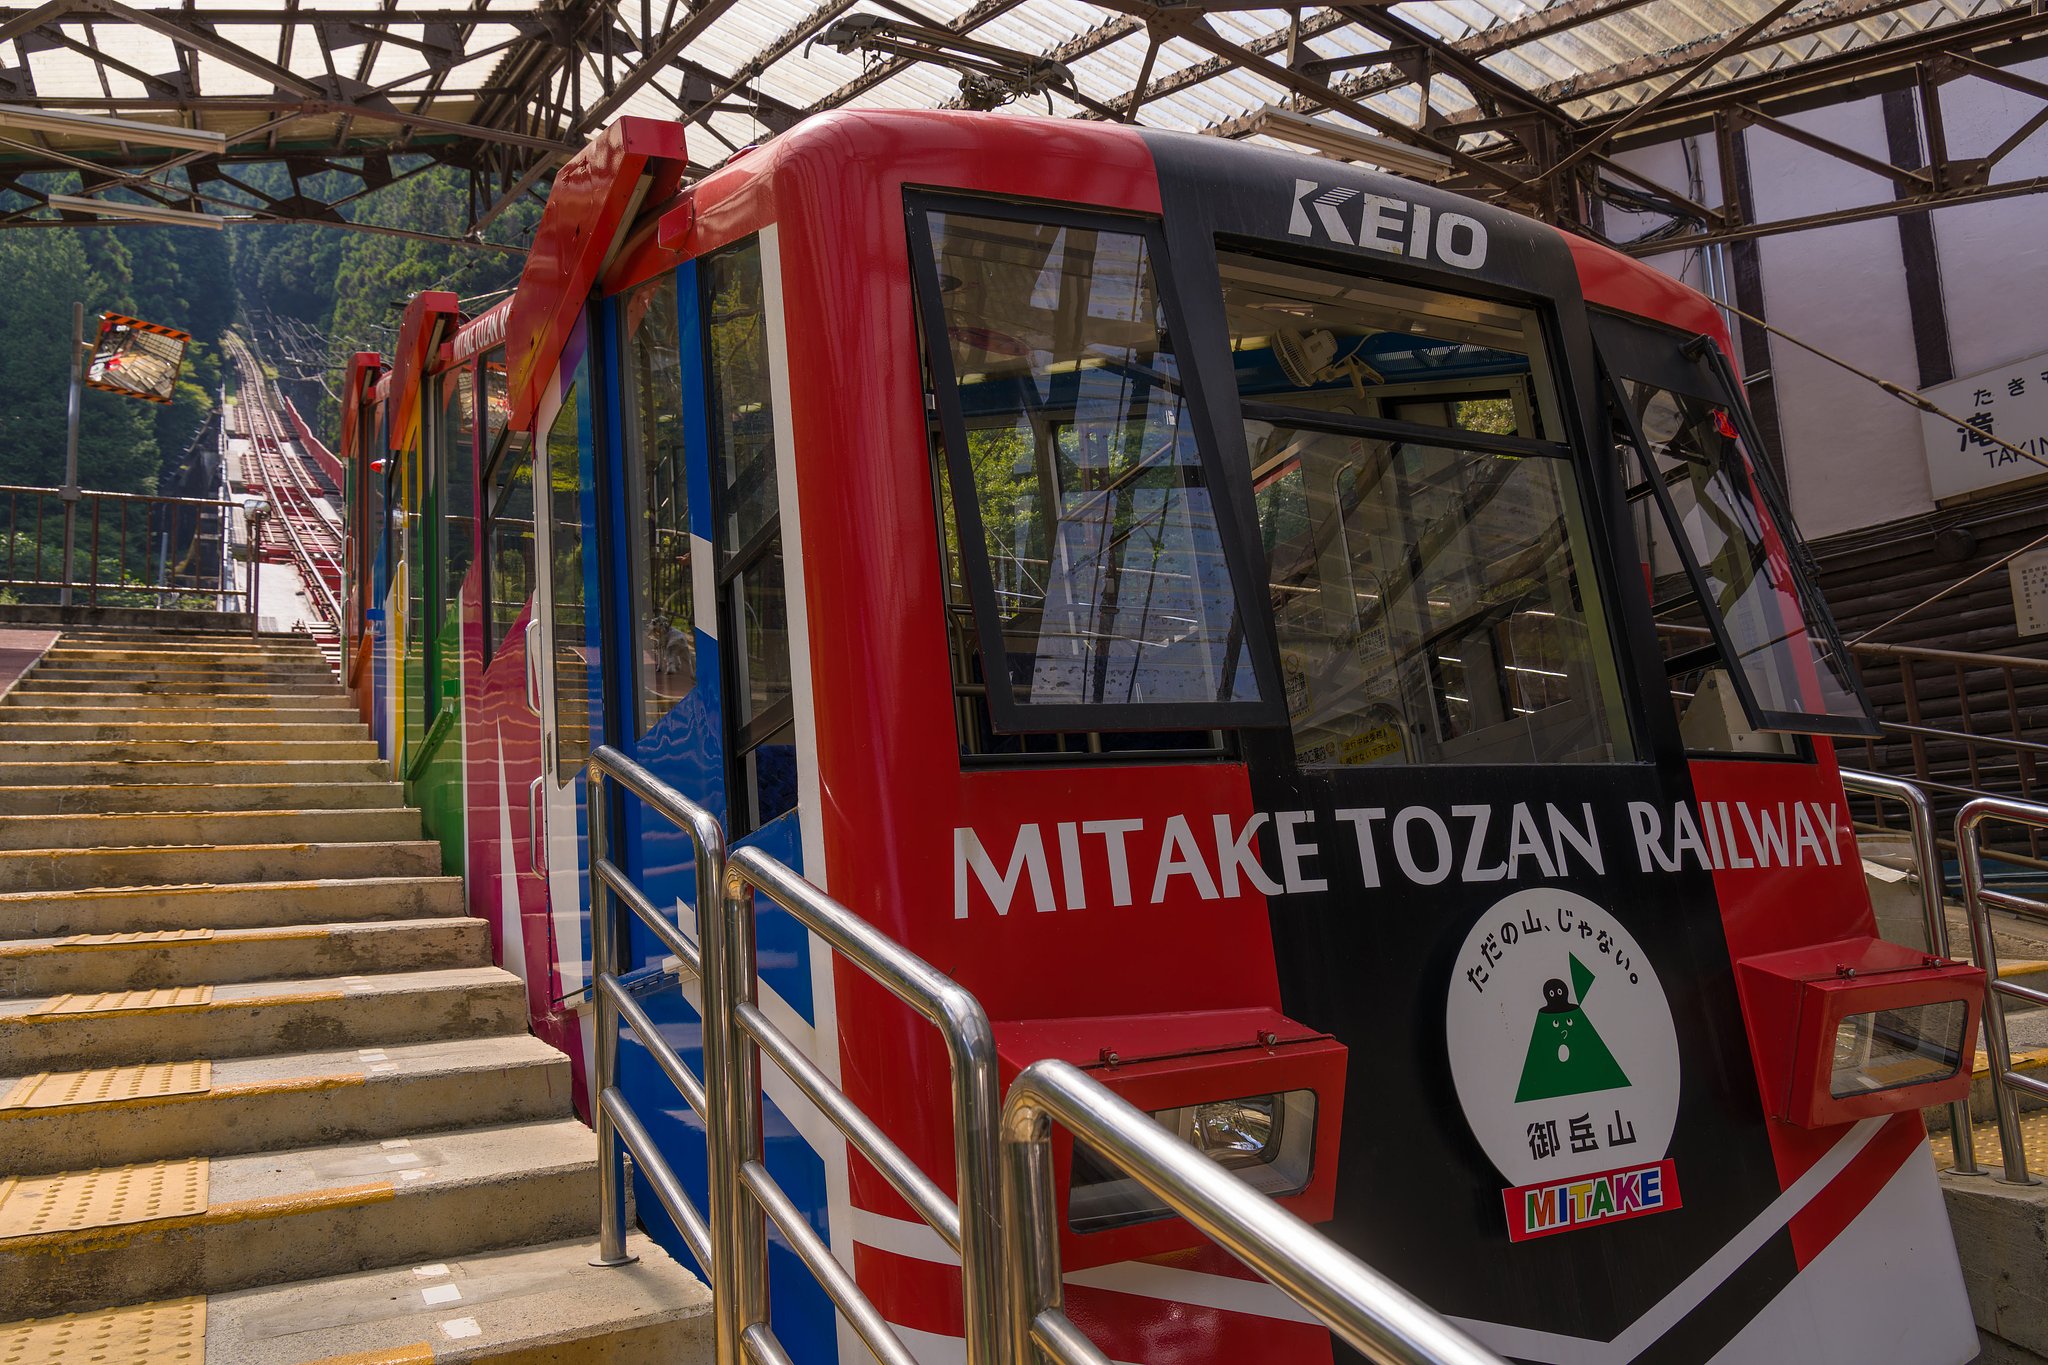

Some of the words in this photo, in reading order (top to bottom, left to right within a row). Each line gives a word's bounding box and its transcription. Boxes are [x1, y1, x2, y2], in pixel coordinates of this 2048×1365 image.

[1288, 178, 1488, 270] KEIO
[475, 310, 499, 350] TOZAN
[953, 811, 1327, 919] MITAKE
[1335, 801, 1604, 887] TOZAN
[1628, 801, 1843, 874] RAILWAY
[1467, 908, 1639, 993] ただの山、じゃない。
[1527, 1110, 1637, 1161] 御岳山
[1525, 1166, 1664, 1234] MITAKE
